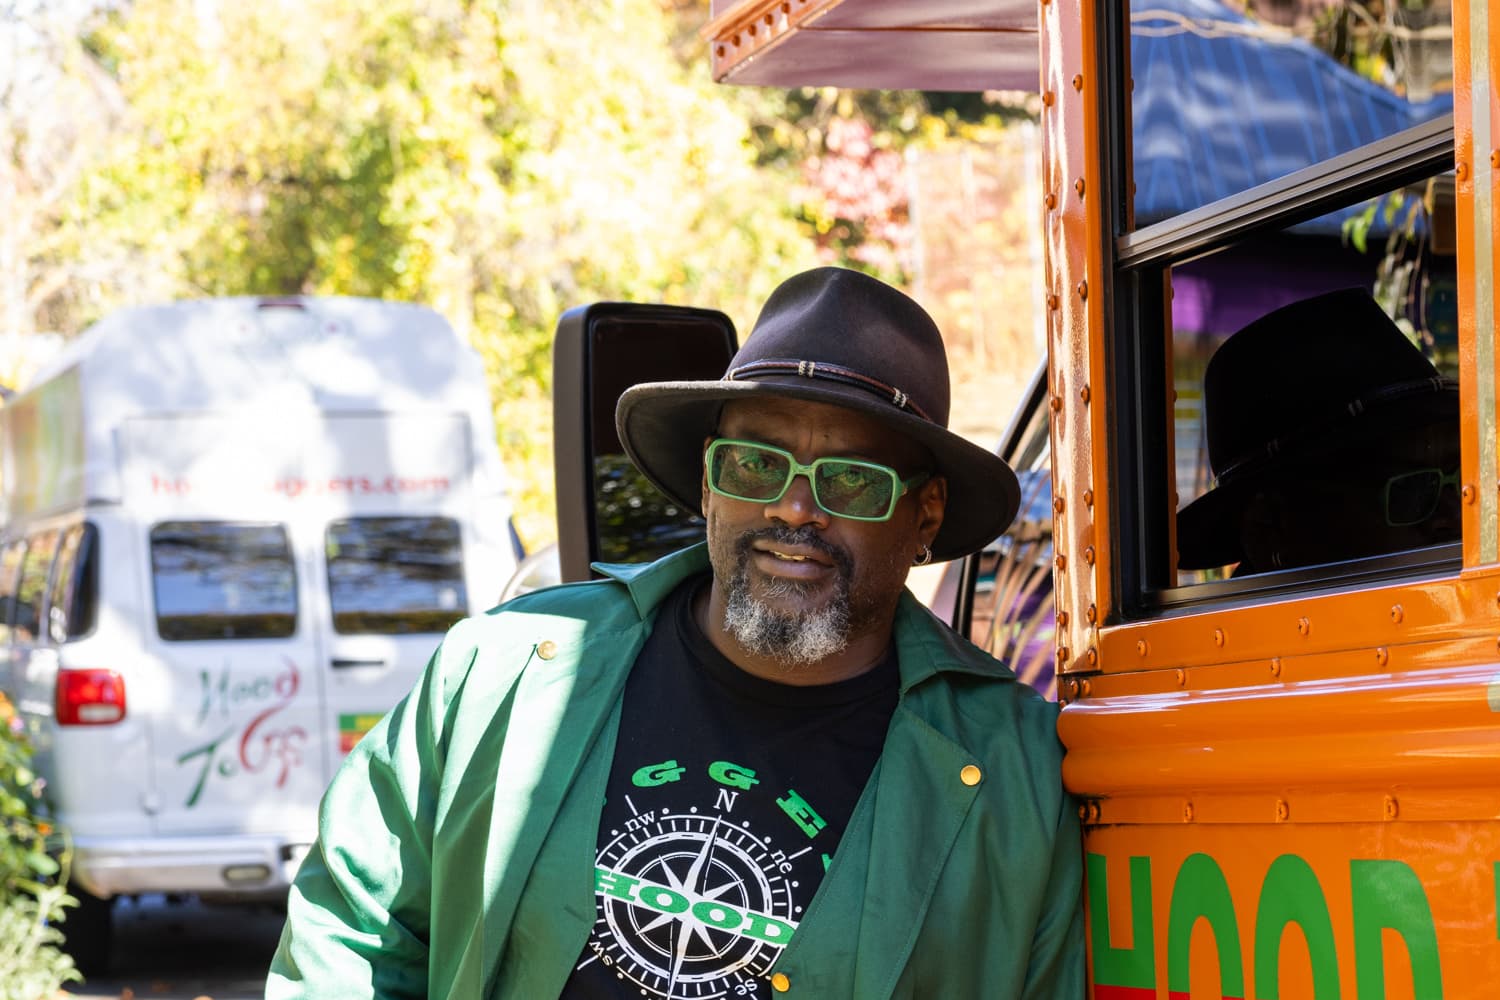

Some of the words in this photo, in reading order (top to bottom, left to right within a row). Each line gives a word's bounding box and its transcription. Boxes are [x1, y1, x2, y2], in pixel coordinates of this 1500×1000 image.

[713, 788, 739, 813] N
[625, 811, 656, 833] nw
[770, 849, 793, 875] ne
[595, 868, 798, 945] HOOD
